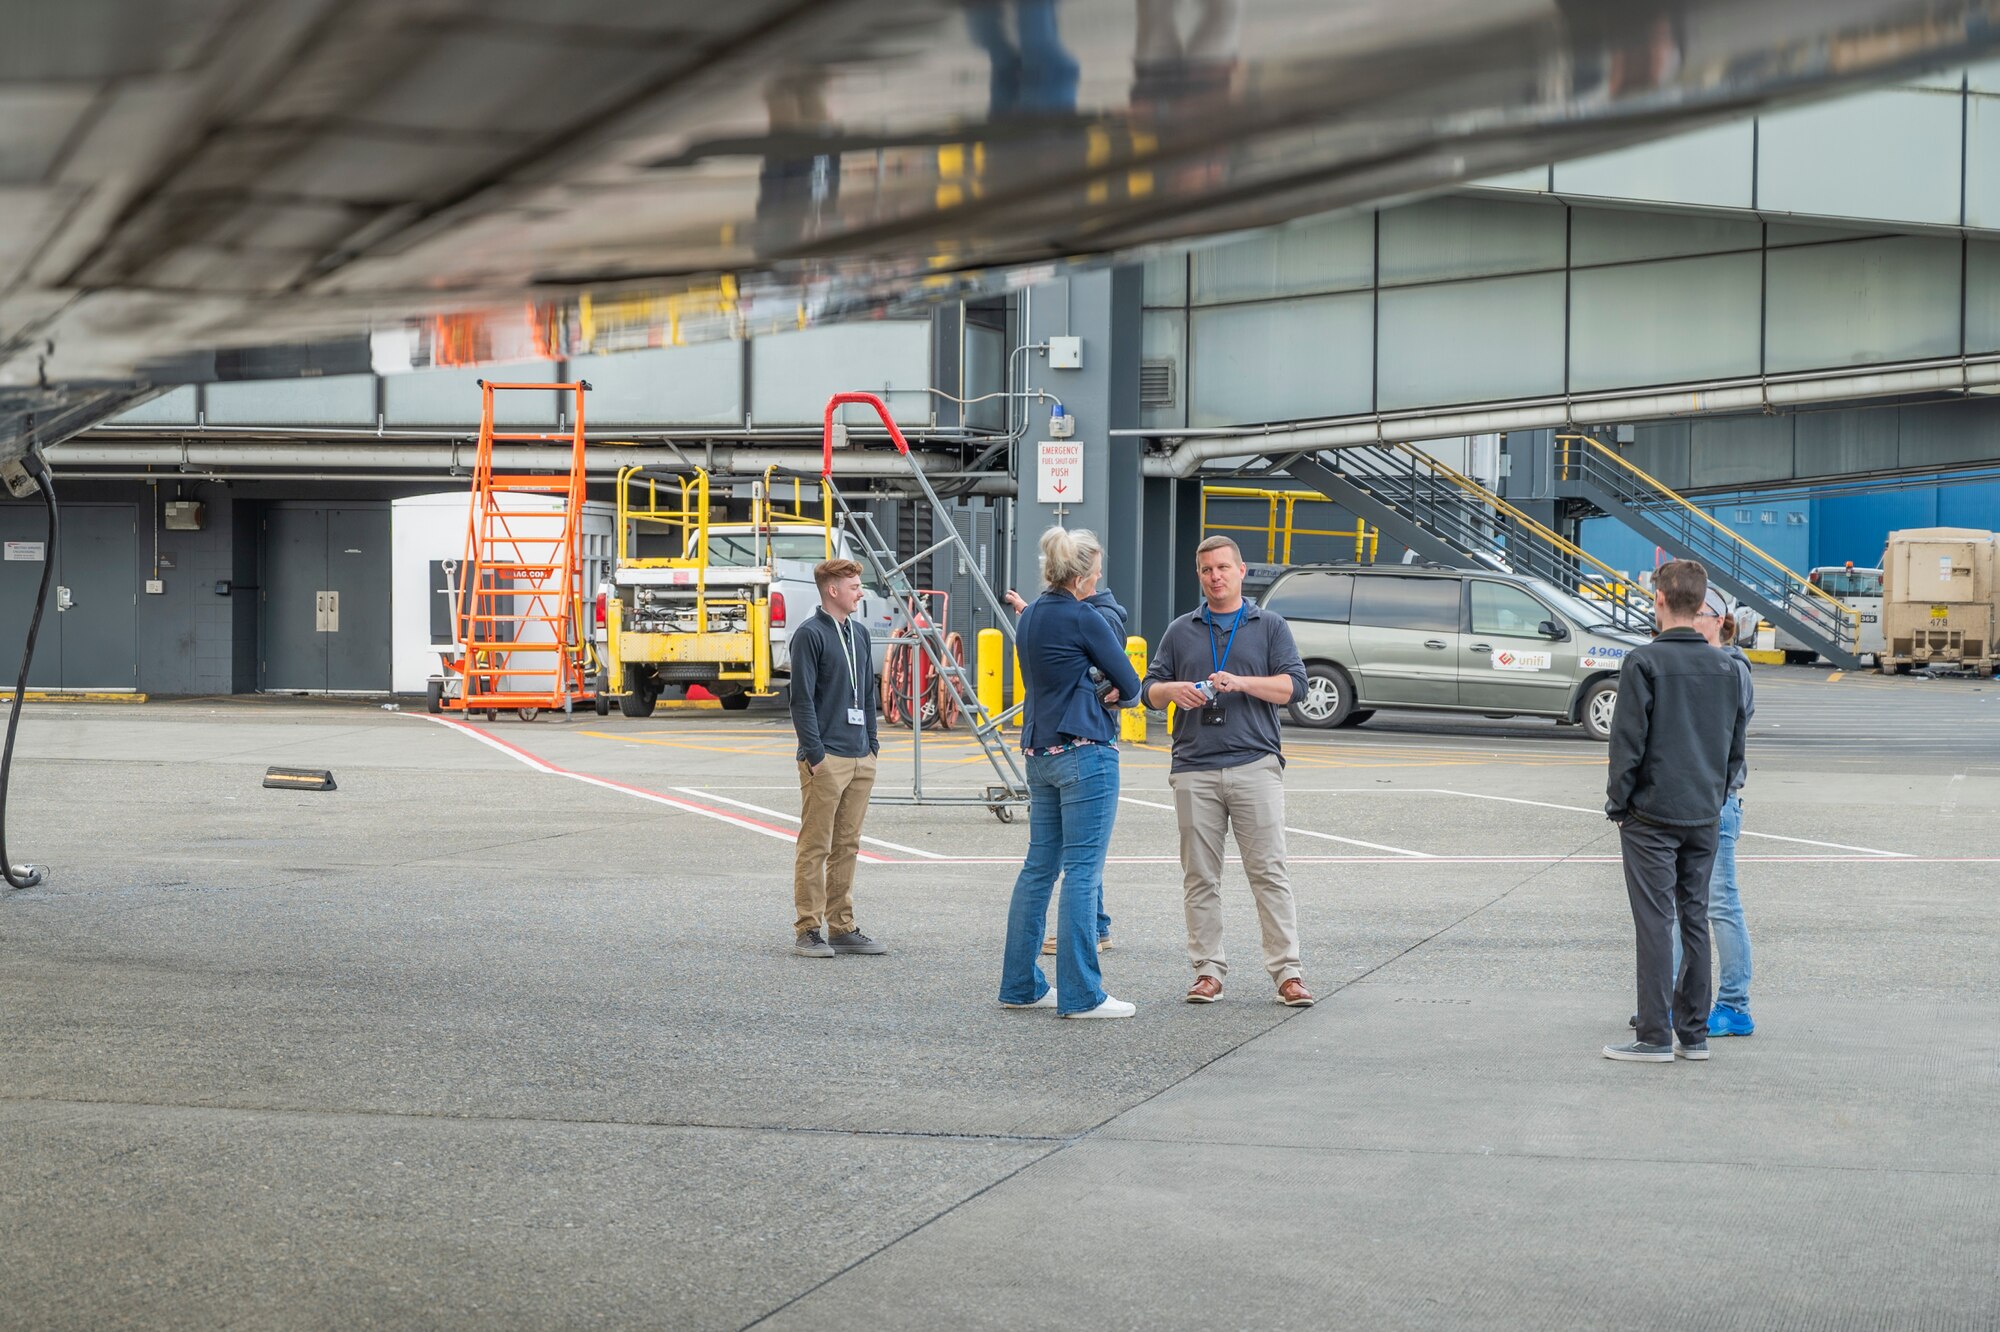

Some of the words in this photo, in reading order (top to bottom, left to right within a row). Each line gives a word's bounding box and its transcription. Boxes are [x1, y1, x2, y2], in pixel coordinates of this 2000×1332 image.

[1042, 446, 1079, 455] EMERGENCY
[1051, 467, 1069, 477] PUSH
[1930, 618, 1948, 626] 479
[1519, 655, 1545, 666] unifi
